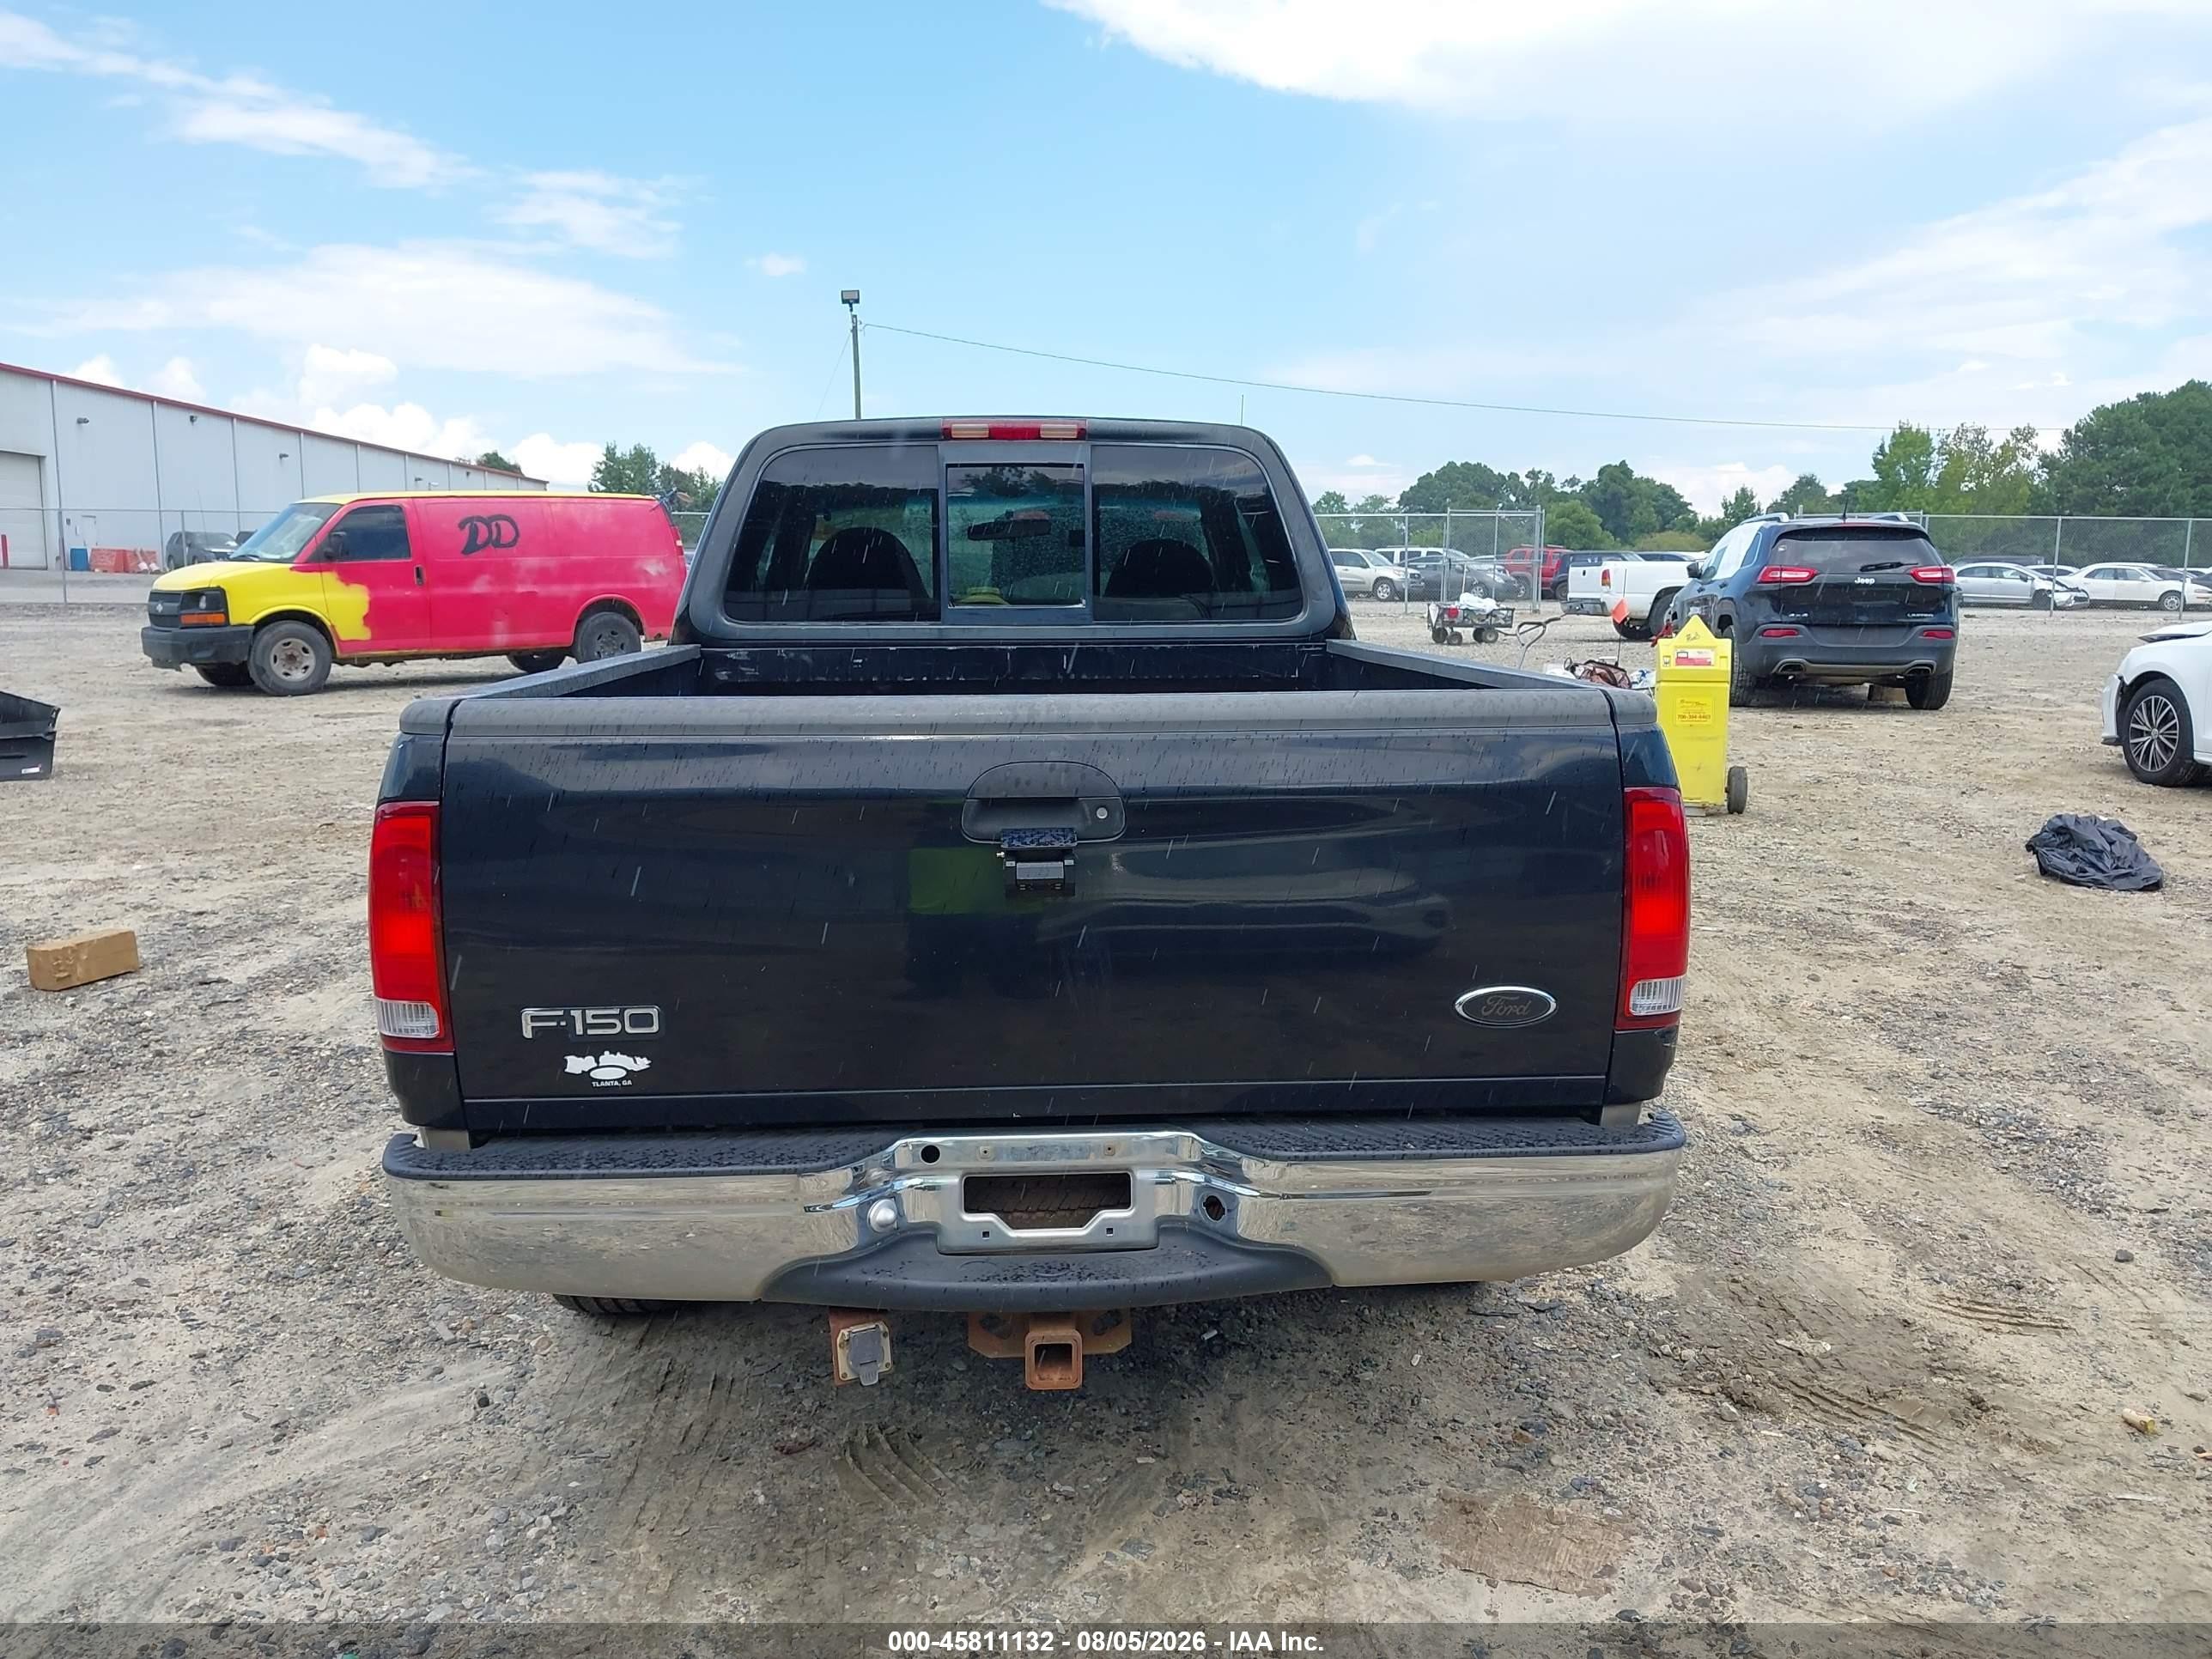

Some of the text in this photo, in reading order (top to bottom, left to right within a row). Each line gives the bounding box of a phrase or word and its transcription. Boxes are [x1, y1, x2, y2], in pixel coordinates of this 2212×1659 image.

[1854, 576, 1875, 586] Jeep
[1481, 995, 1532, 1017] Ford
[520, 1006, 659, 1039] F-150
